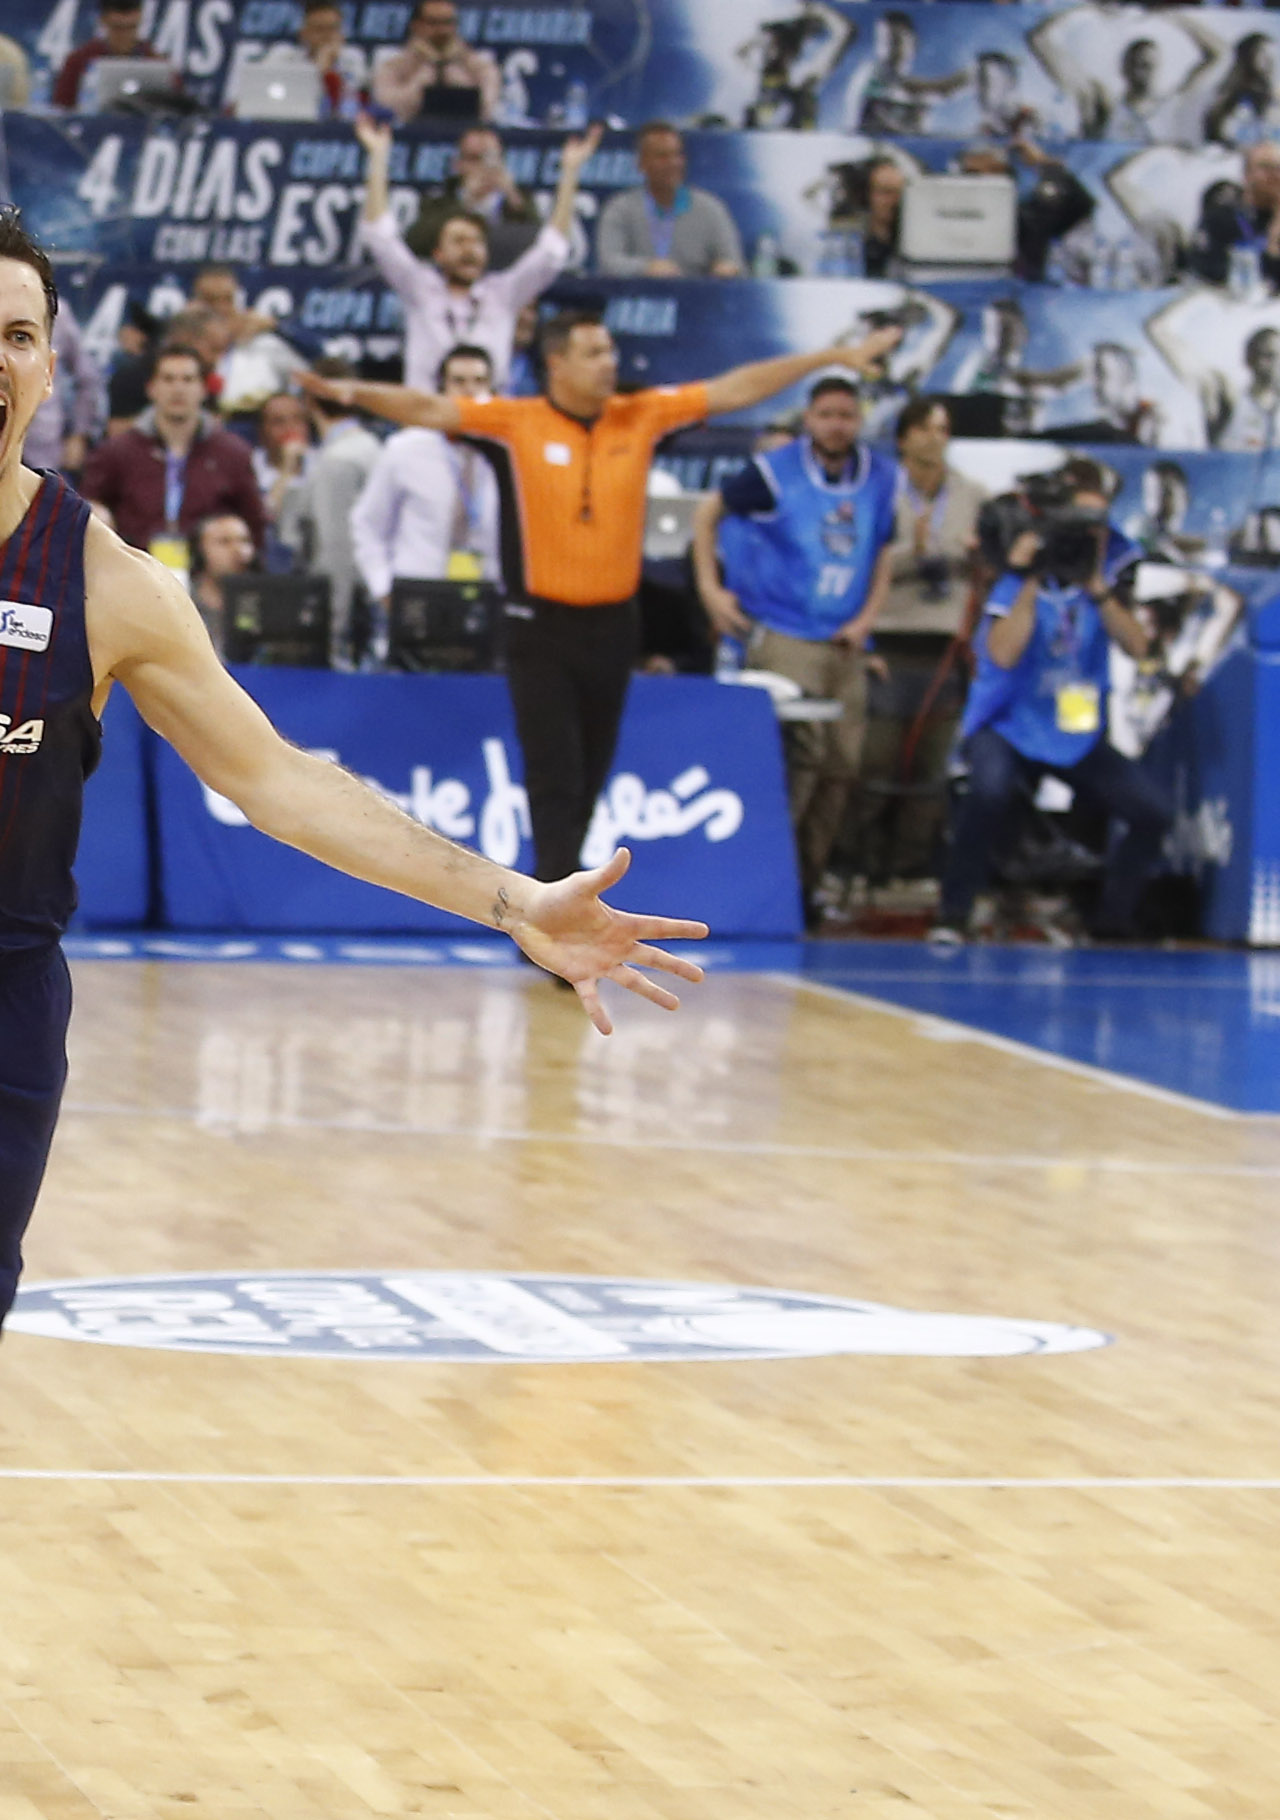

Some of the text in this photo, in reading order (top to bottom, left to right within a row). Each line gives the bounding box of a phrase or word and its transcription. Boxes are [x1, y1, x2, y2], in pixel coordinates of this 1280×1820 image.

[77, 122, 283, 222] 4 DÍAS
[289, 138, 363, 178] COPA
